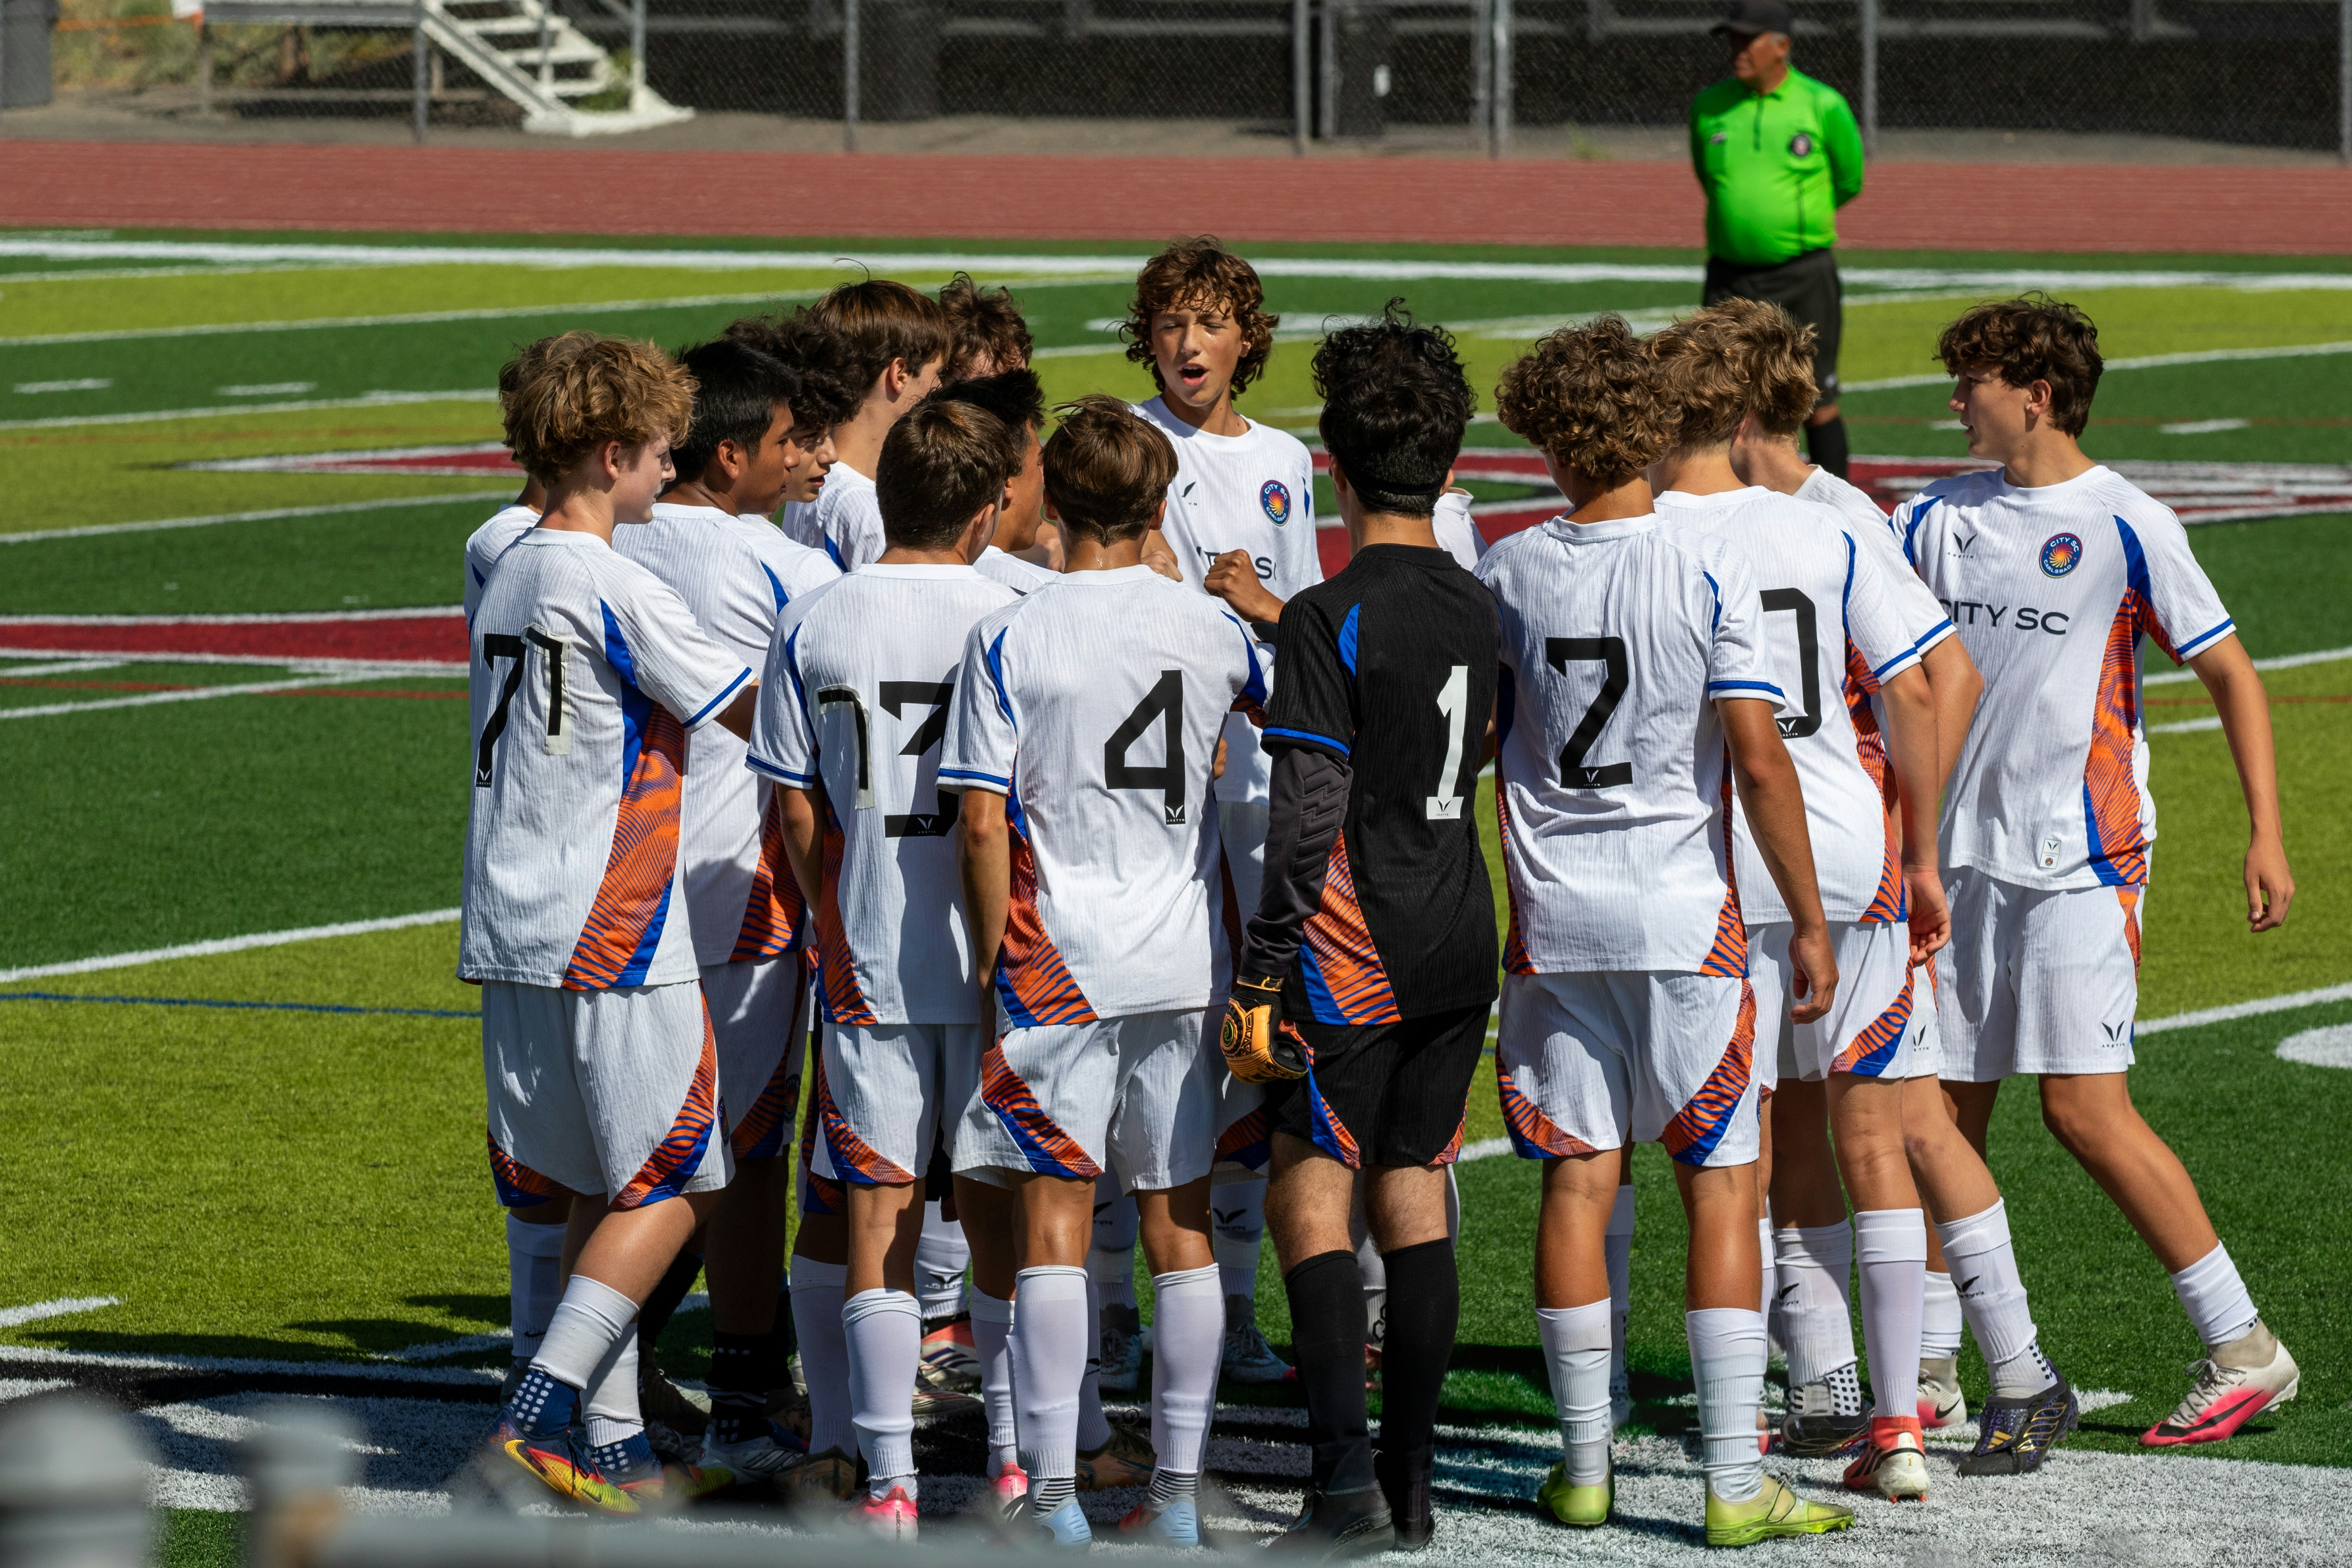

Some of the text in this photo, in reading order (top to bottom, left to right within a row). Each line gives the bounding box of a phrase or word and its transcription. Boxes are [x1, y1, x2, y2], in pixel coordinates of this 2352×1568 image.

[1264, 484, 1288, 500] CITY SC
[1266, 507, 1287, 522] CARLSBAD
[2050, 537, 2079, 552] CITY SC
[1255, 557, 1277, 581] S
[2044, 559, 2072, 574] CARLSBAD
[2015, 607, 2070, 635] SC
[476, 628, 563, 787] 71
[1546, 636, 1633, 789] 2
[1104, 670, 1186, 825] 4
[1426, 666, 1468, 820] 1
[818, 681, 959, 838] 13
